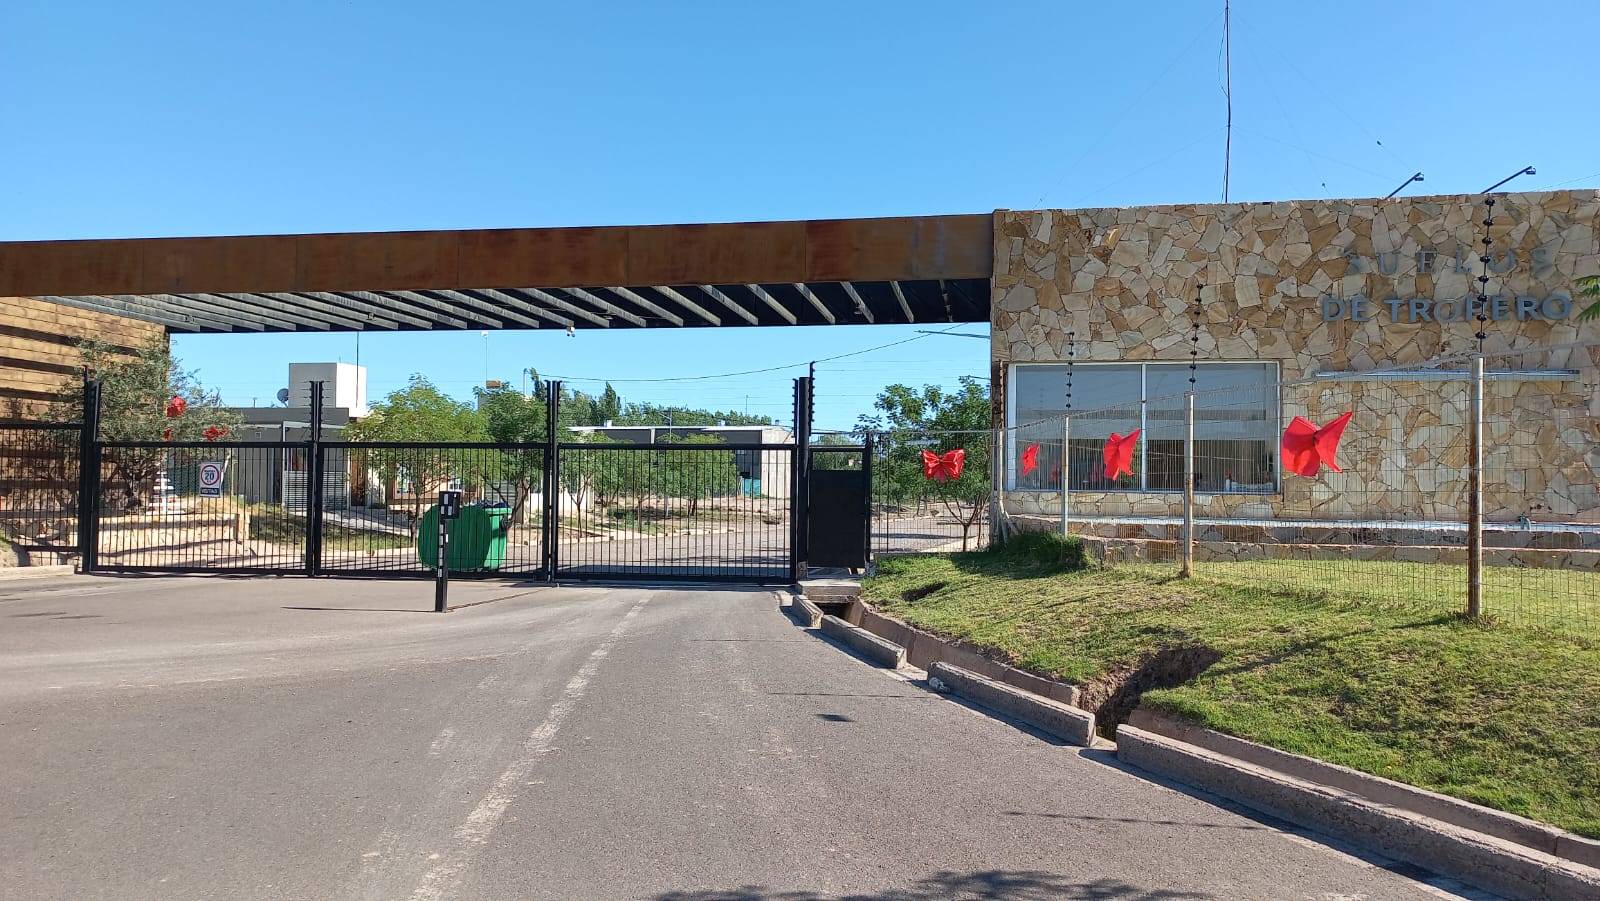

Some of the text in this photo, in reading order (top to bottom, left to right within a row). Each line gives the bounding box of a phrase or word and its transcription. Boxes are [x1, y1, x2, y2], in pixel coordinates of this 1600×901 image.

[1322, 294, 1573, 322] DE TROPERO
[204, 472, 215, 481] 20
